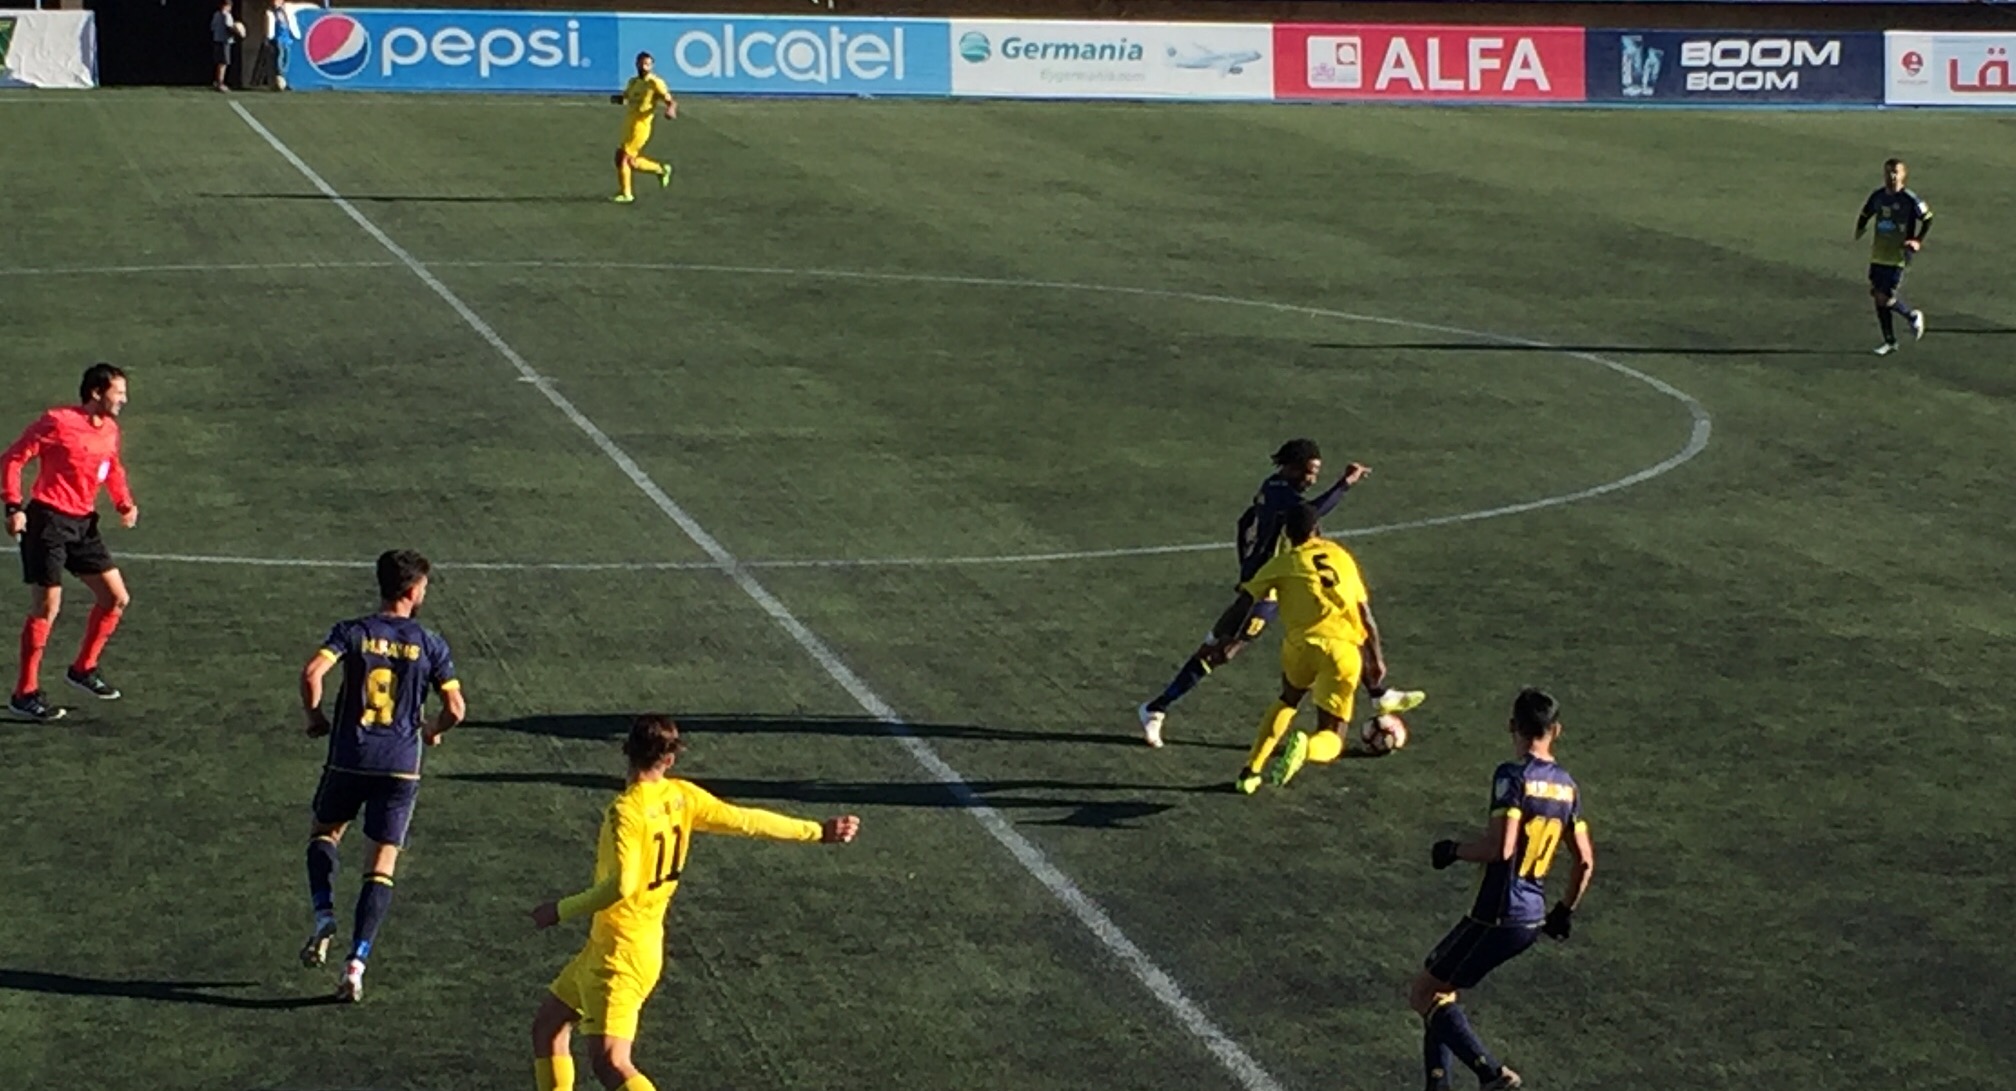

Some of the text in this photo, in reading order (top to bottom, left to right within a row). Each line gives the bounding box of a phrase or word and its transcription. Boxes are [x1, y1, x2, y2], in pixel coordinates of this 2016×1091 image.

[381, 20, 580, 76] pepsi
[675, 24, 904, 83] alcatel
[1001, 36, 1144, 63] Germania
[1375, 37, 1551, 91] ALFA
[1680, 39, 1841, 68] BOOM
[1685, 71, 1799, 91] BOOM
[1312, 552, 1341, 589] 5
[647, 823, 682, 891] 11
[1518, 815, 1563, 878] 10
